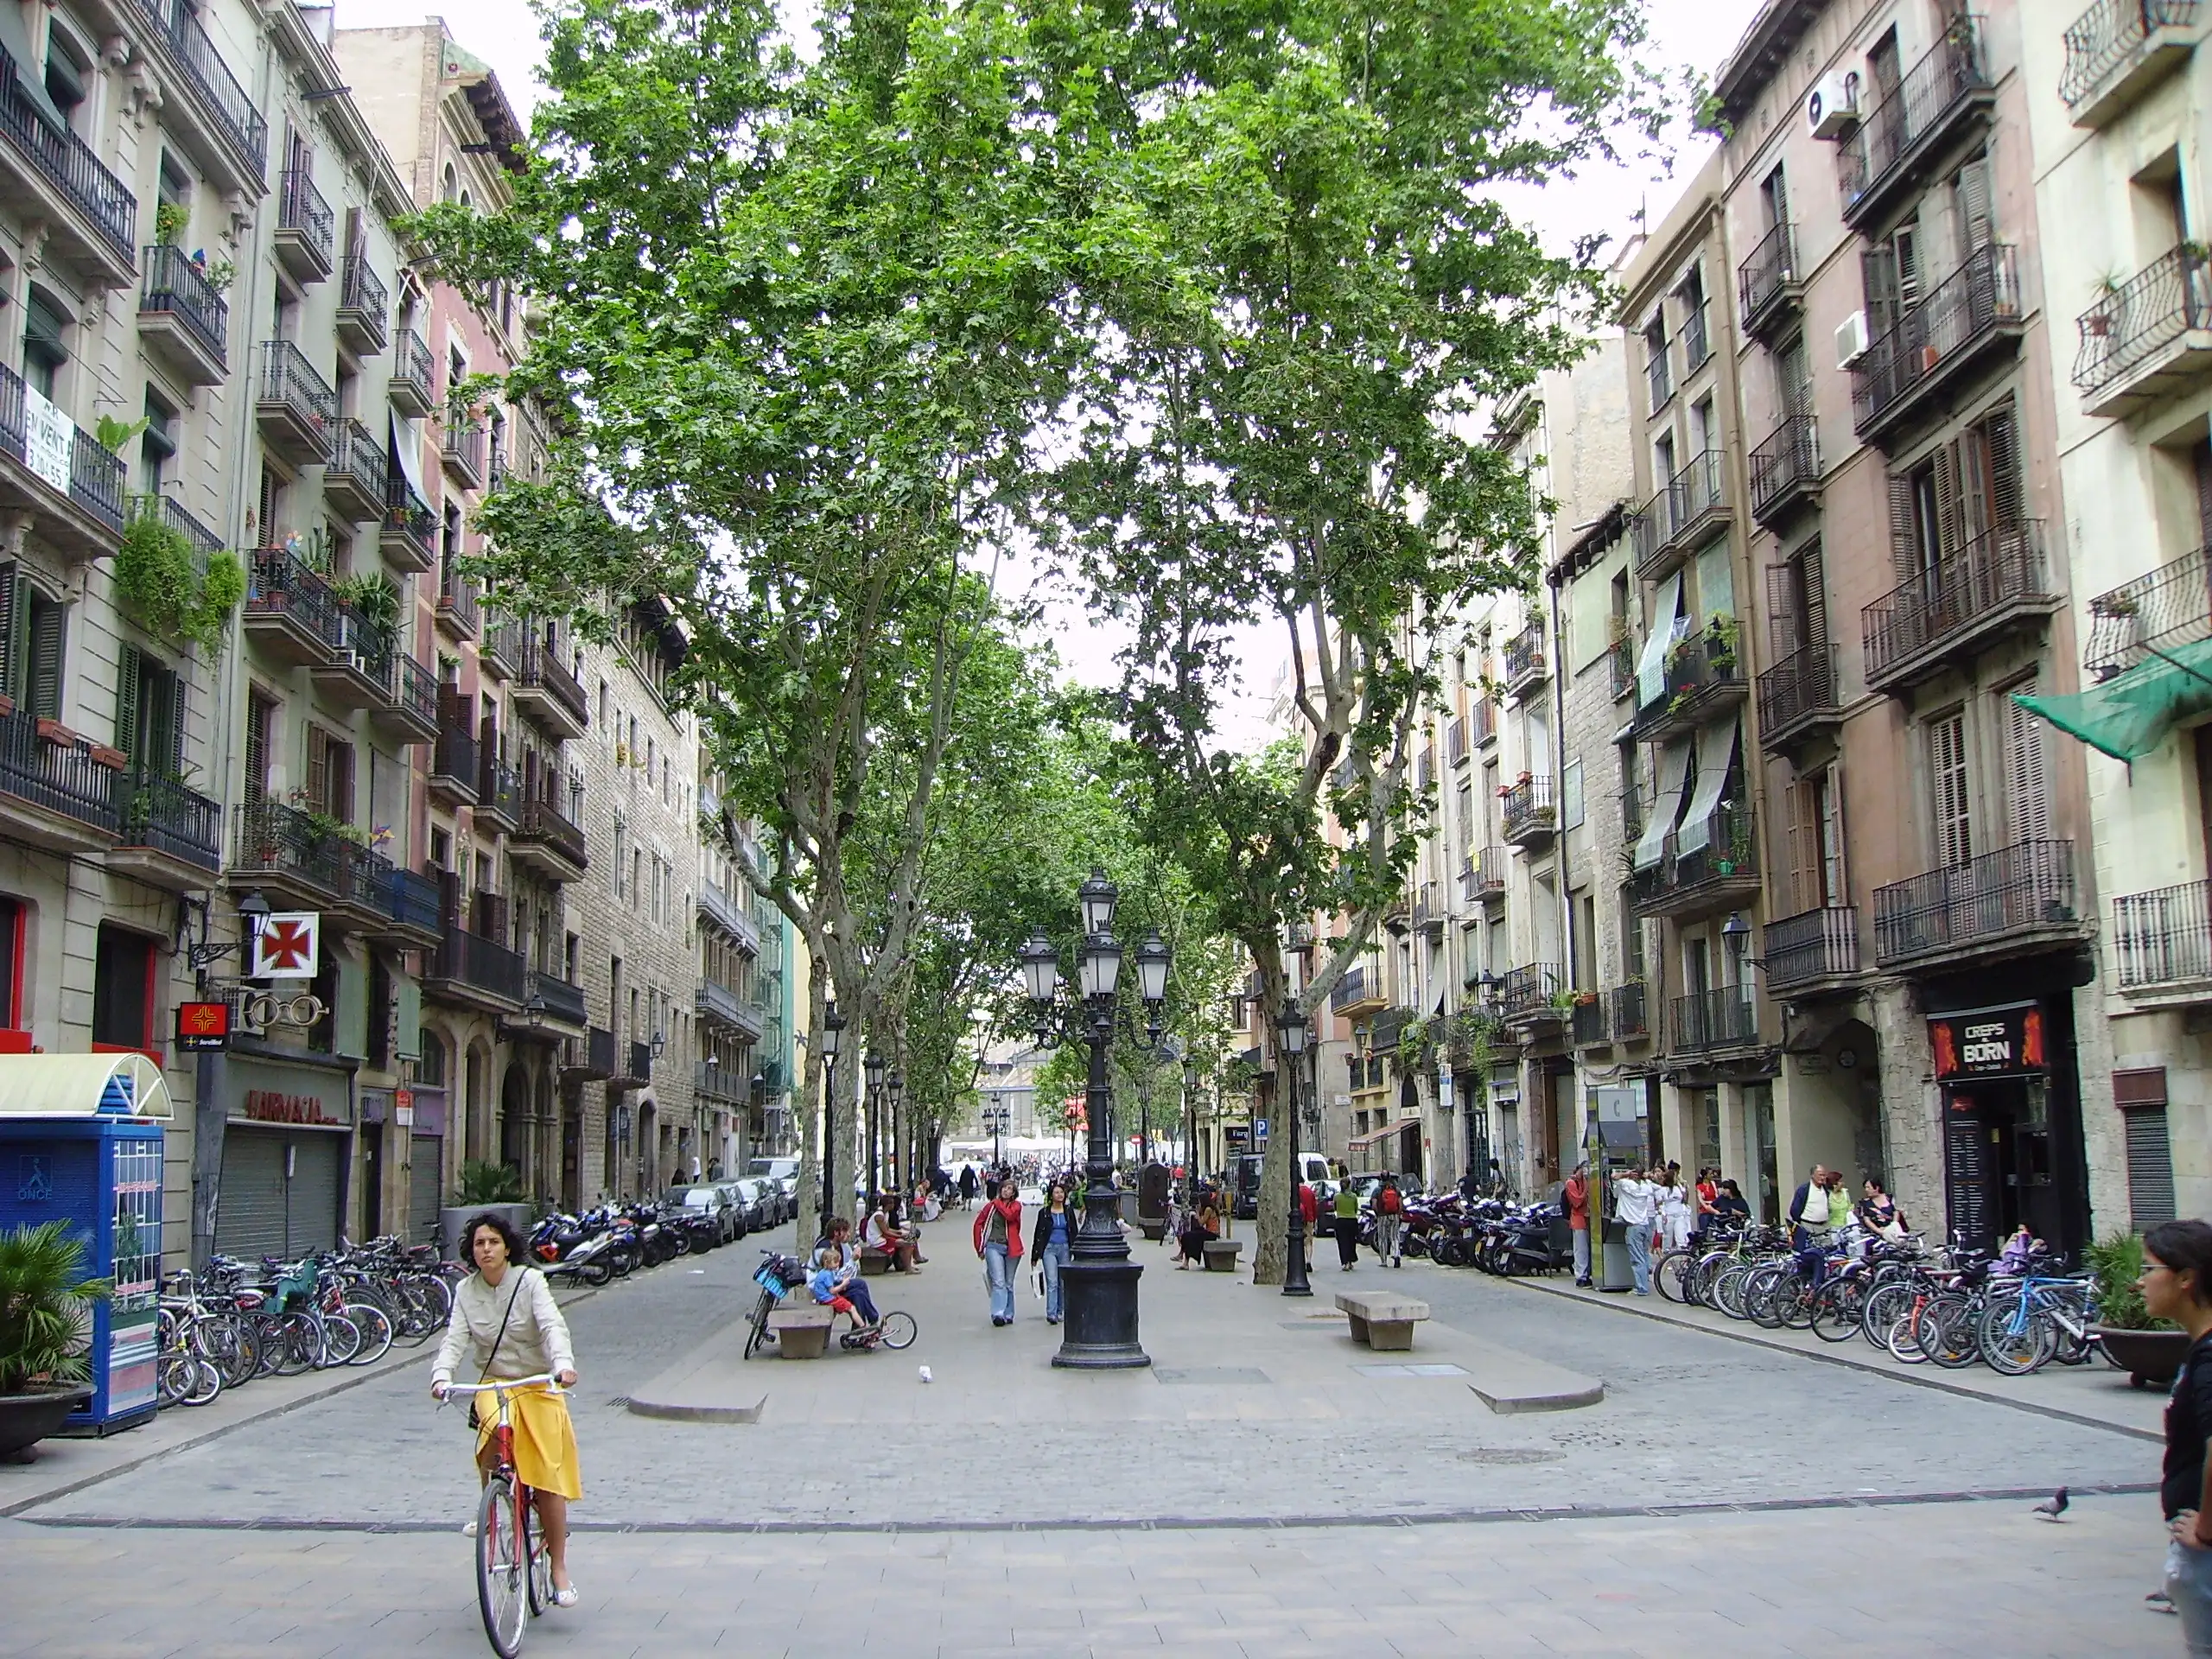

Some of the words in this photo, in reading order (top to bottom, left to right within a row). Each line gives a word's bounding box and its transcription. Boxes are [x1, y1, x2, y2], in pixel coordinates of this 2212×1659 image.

[1965, 1022, 2005, 1039] CREPS
[1963, 1040, 2011, 1063] BORN
[1257, 1121, 1266, 1135] P
[17, 1188, 53, 1200] ONCE
